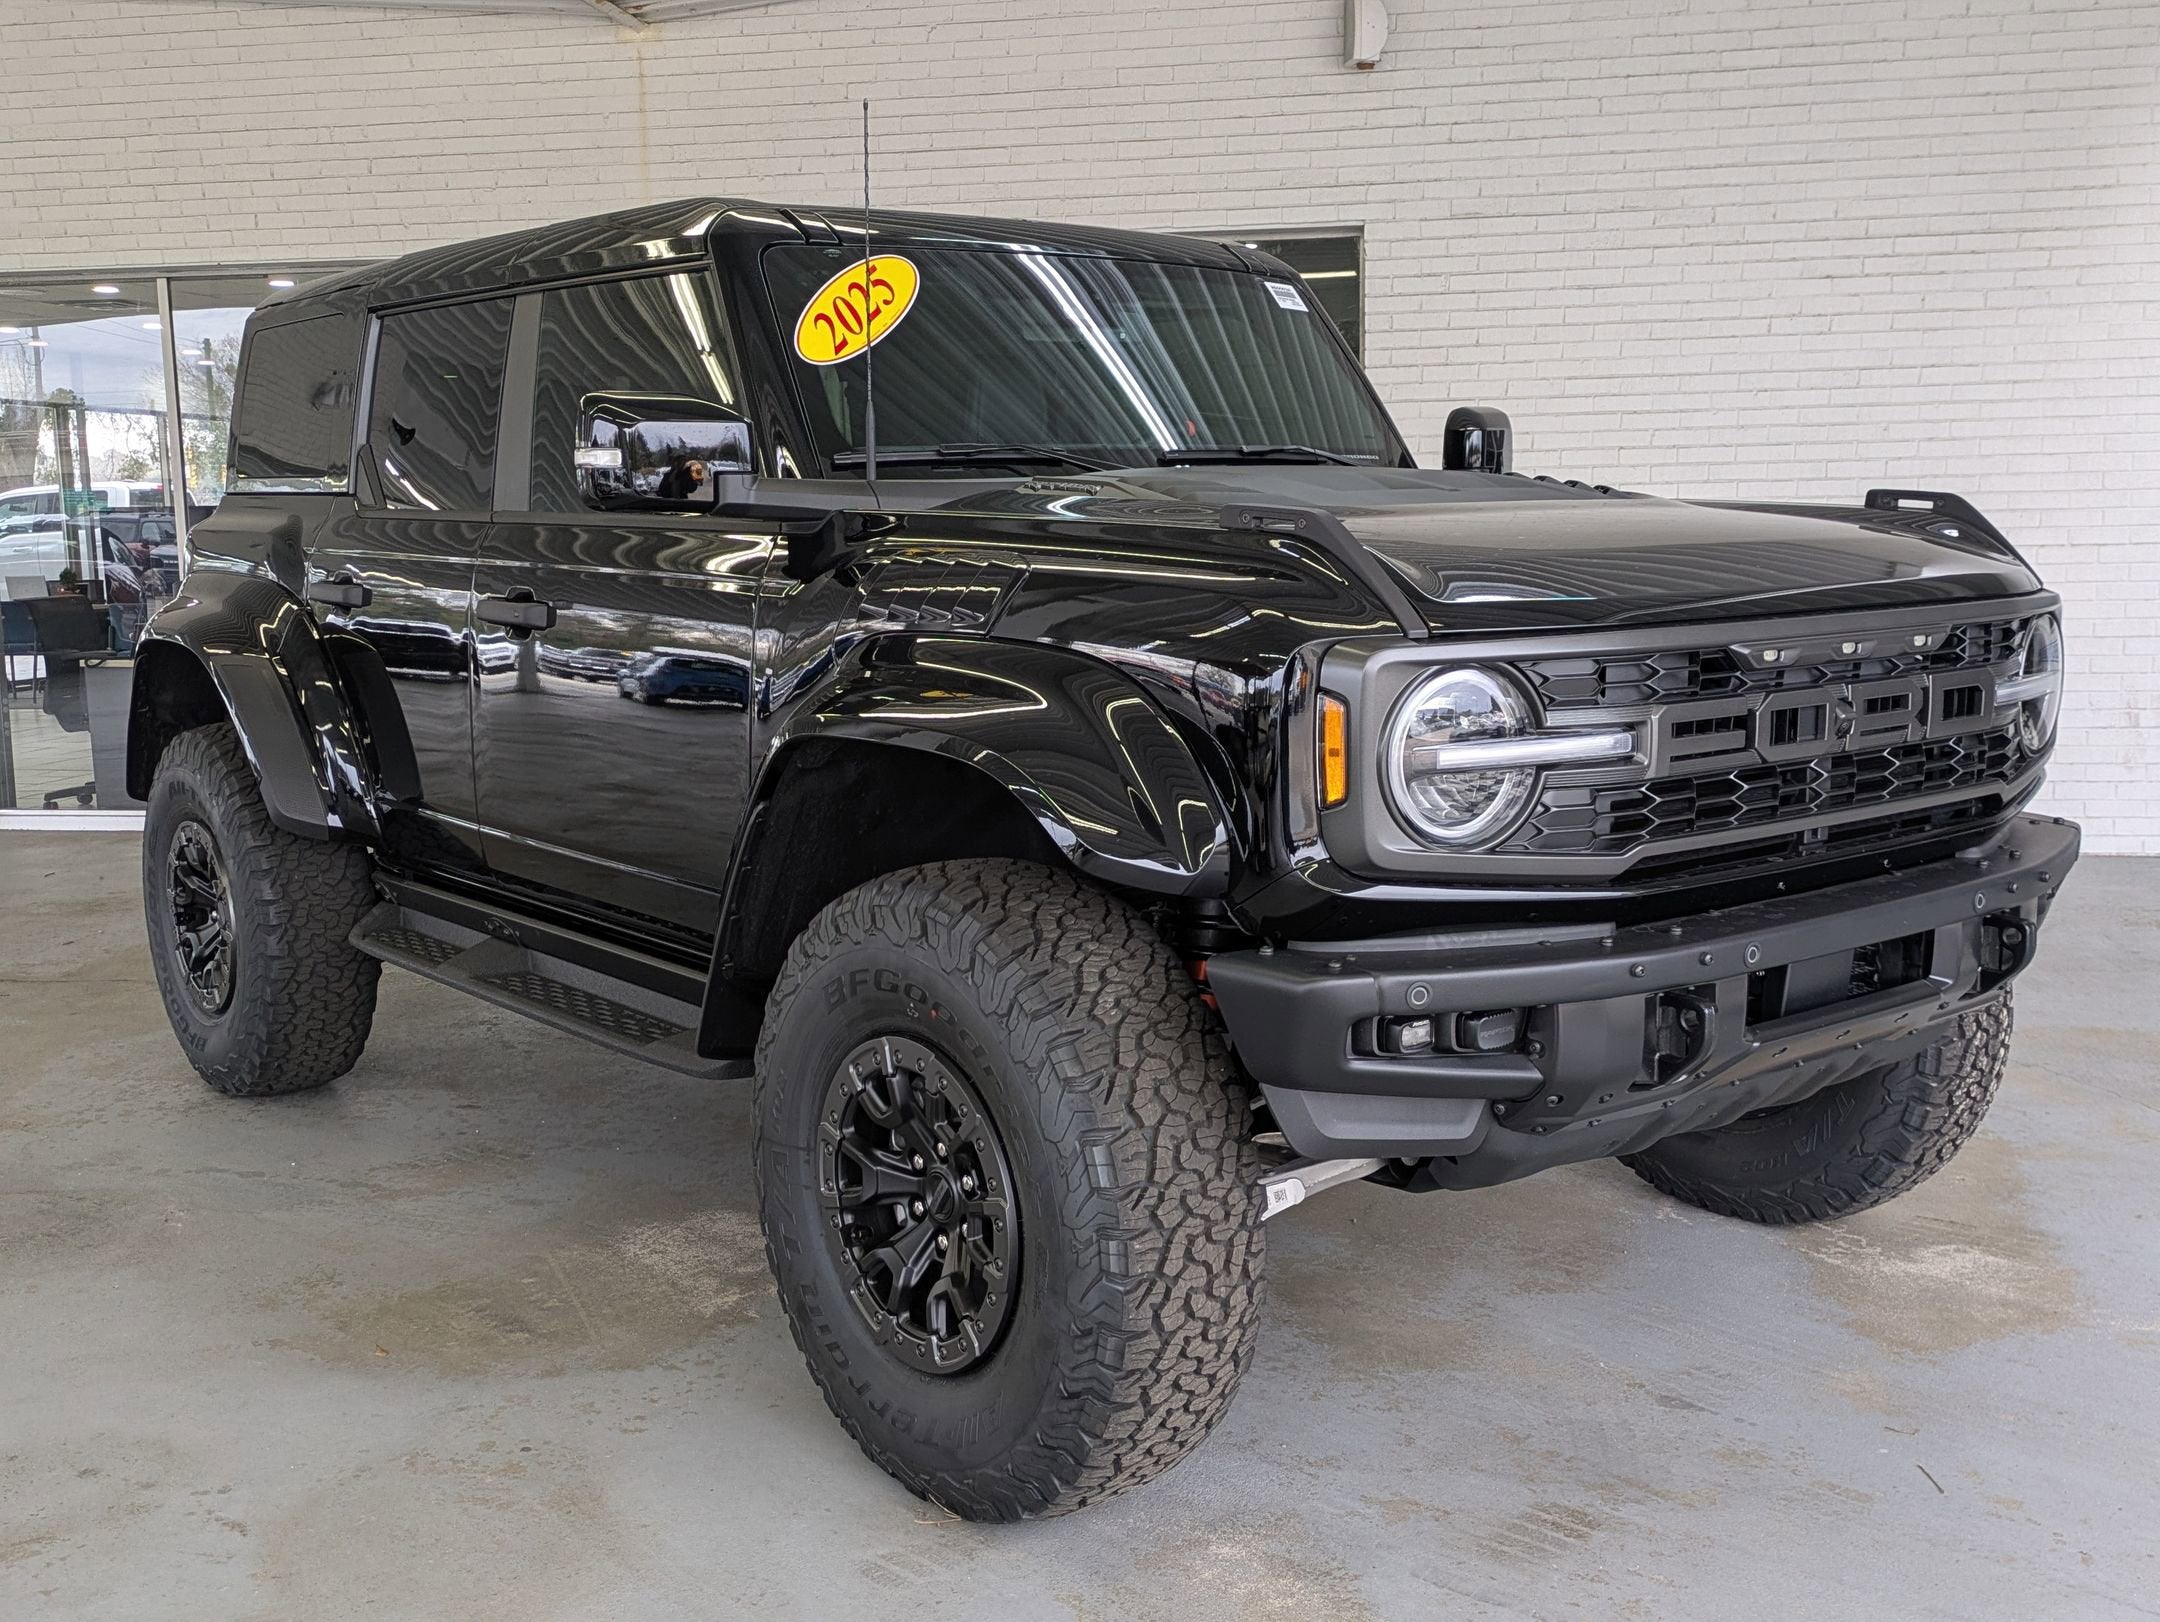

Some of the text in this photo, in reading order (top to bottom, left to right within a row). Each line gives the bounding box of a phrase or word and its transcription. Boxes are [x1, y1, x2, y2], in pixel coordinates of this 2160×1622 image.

[814, 264, 895, 356] 2025
[1651, 668, 1998, 777] FORD
[1480, 1025, 1515, 1038] RAPTOR
